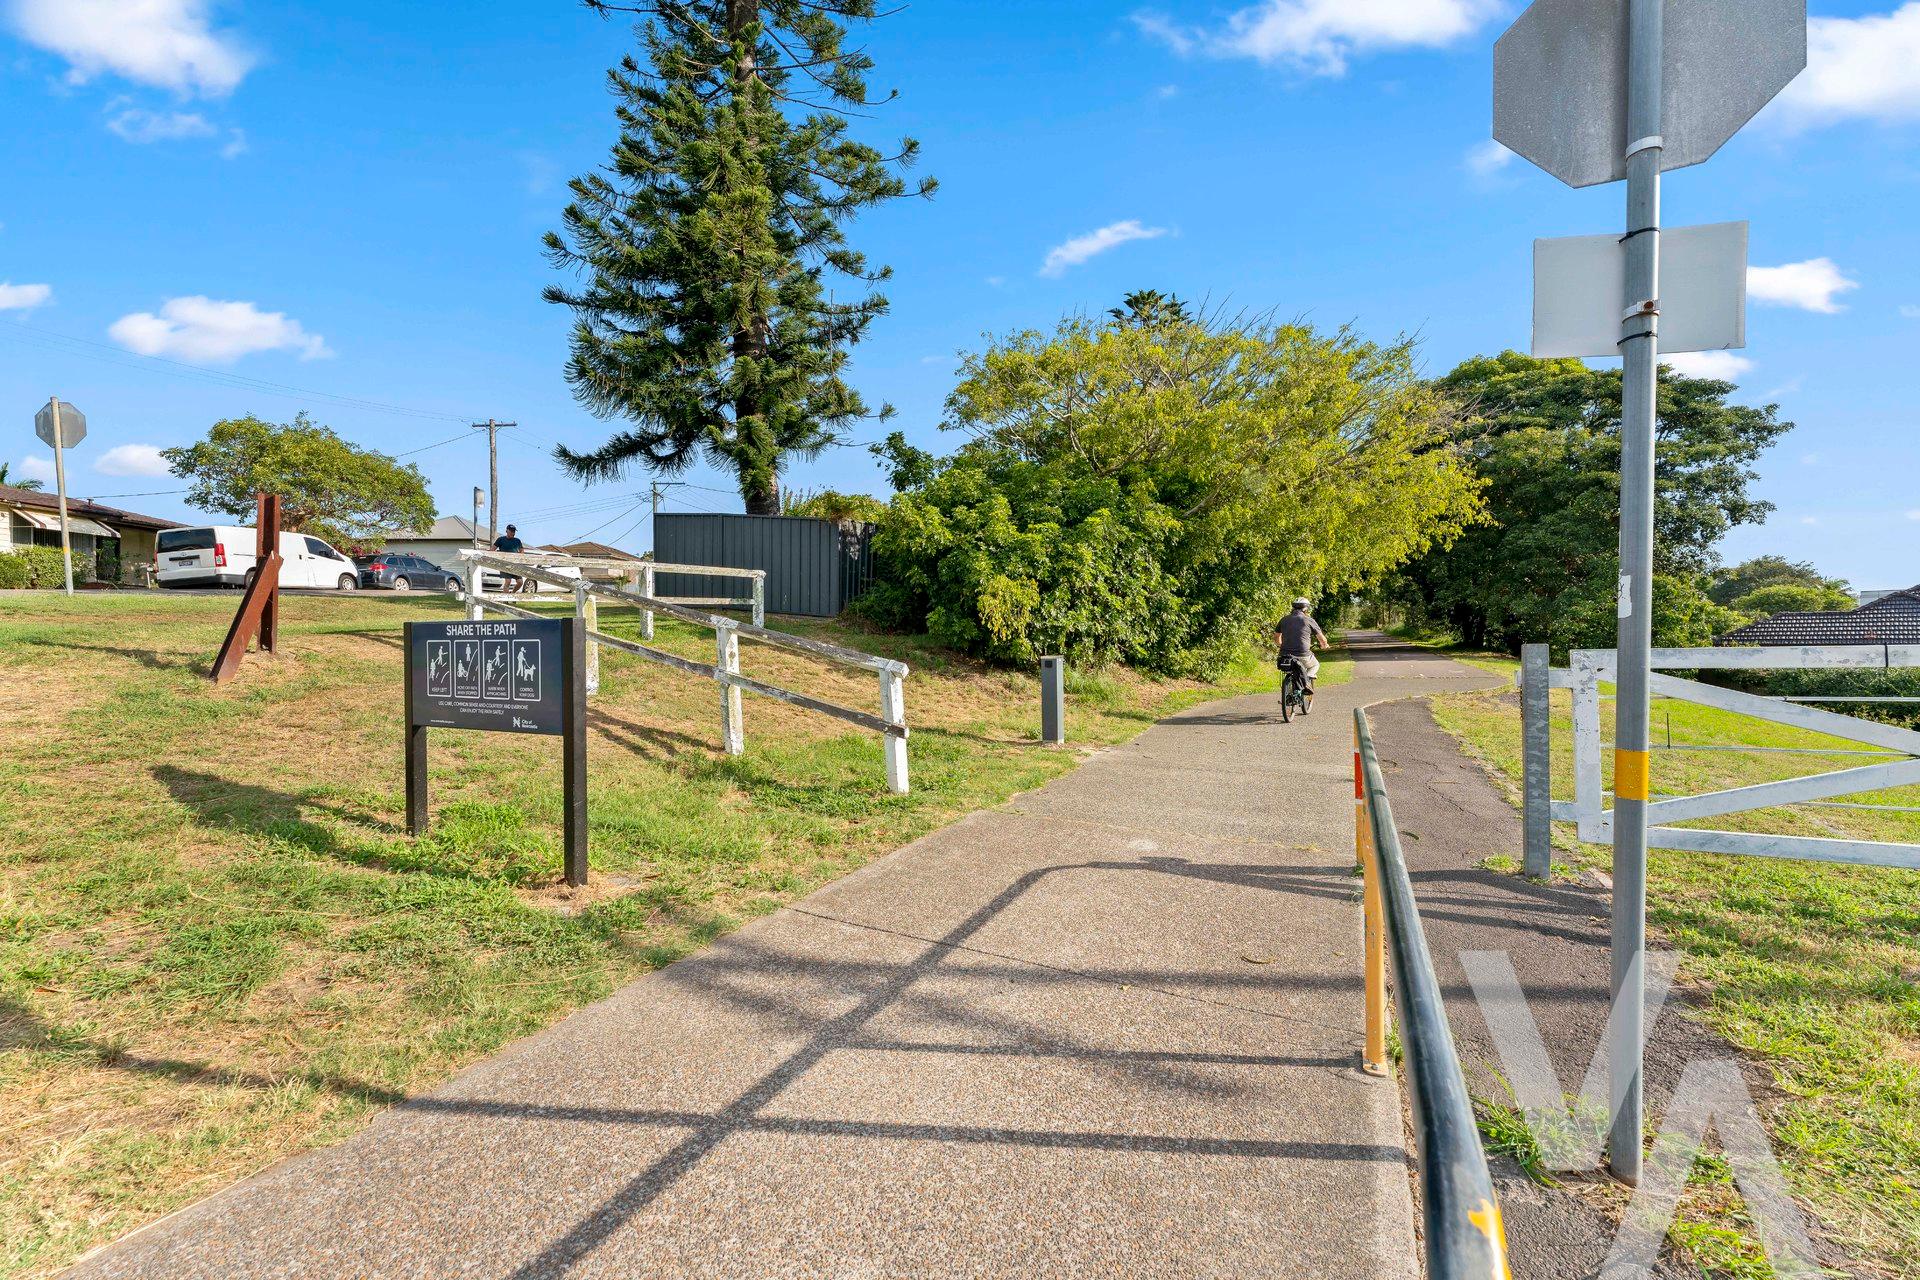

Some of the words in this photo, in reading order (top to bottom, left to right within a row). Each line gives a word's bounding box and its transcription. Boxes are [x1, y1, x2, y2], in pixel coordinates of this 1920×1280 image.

[446, 624, 474, 636] SHARE
[475, 624, 492, 636] THE
[494, 624, 517, 635] PATH
